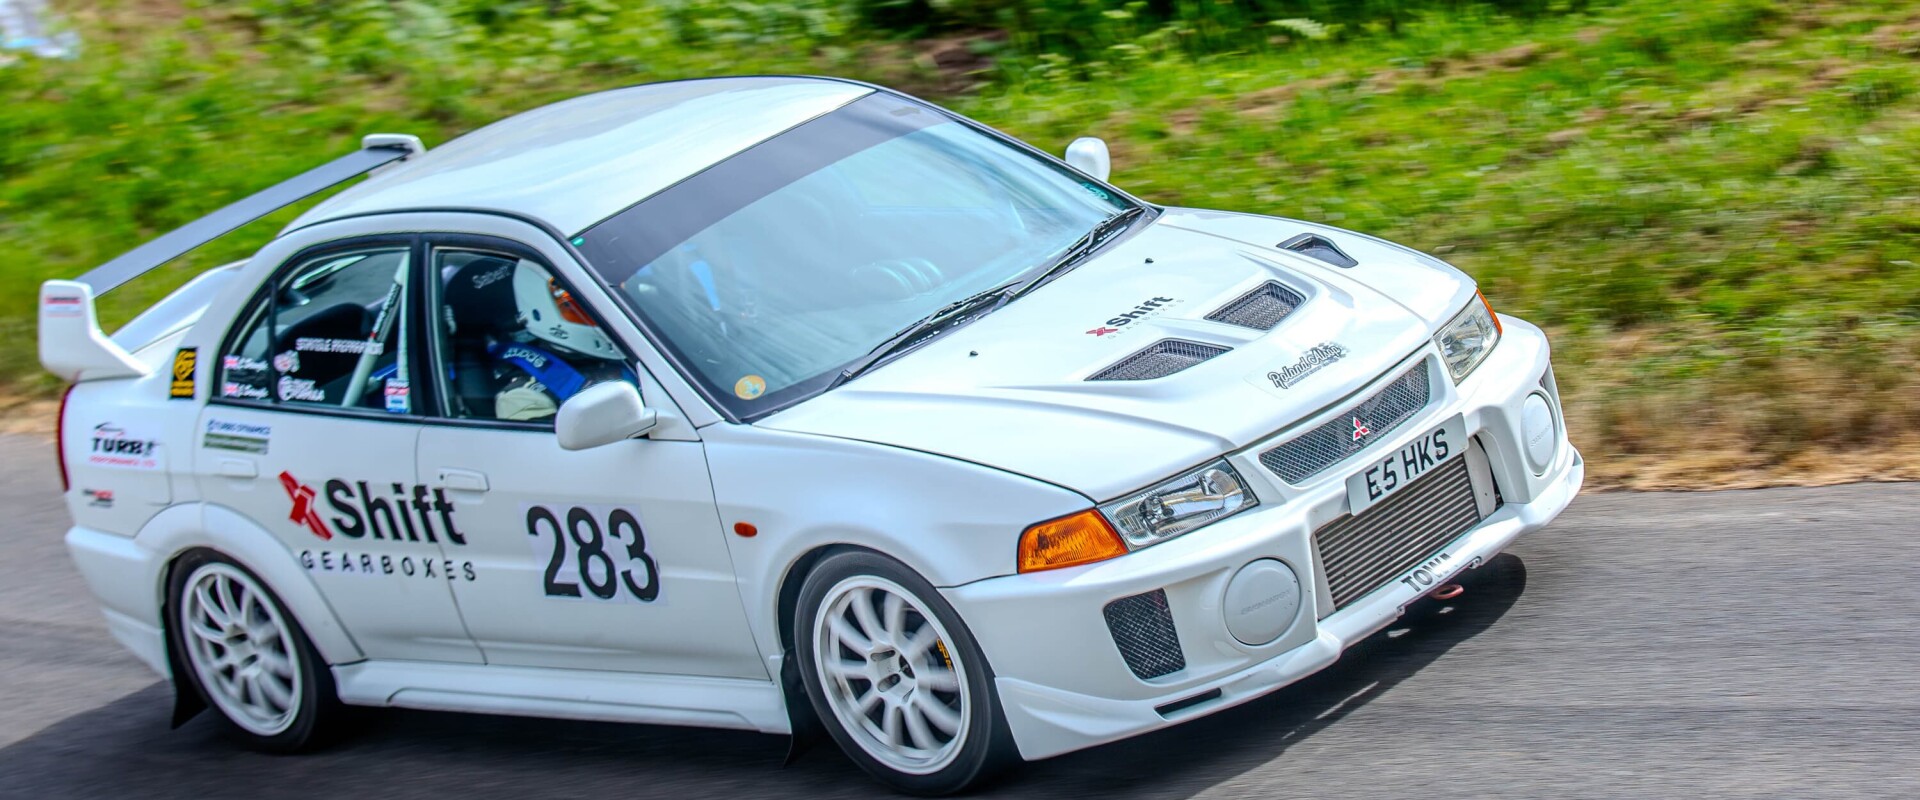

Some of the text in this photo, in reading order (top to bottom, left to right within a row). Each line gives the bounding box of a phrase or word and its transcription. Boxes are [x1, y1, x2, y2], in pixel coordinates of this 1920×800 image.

[1267, 356, 1312, 390] Roland
[1365, 428, 1449, 501] E5 HKS
[300, 550, 477, 582] GEARBOXES
[526, 505, 660, 603] 283
